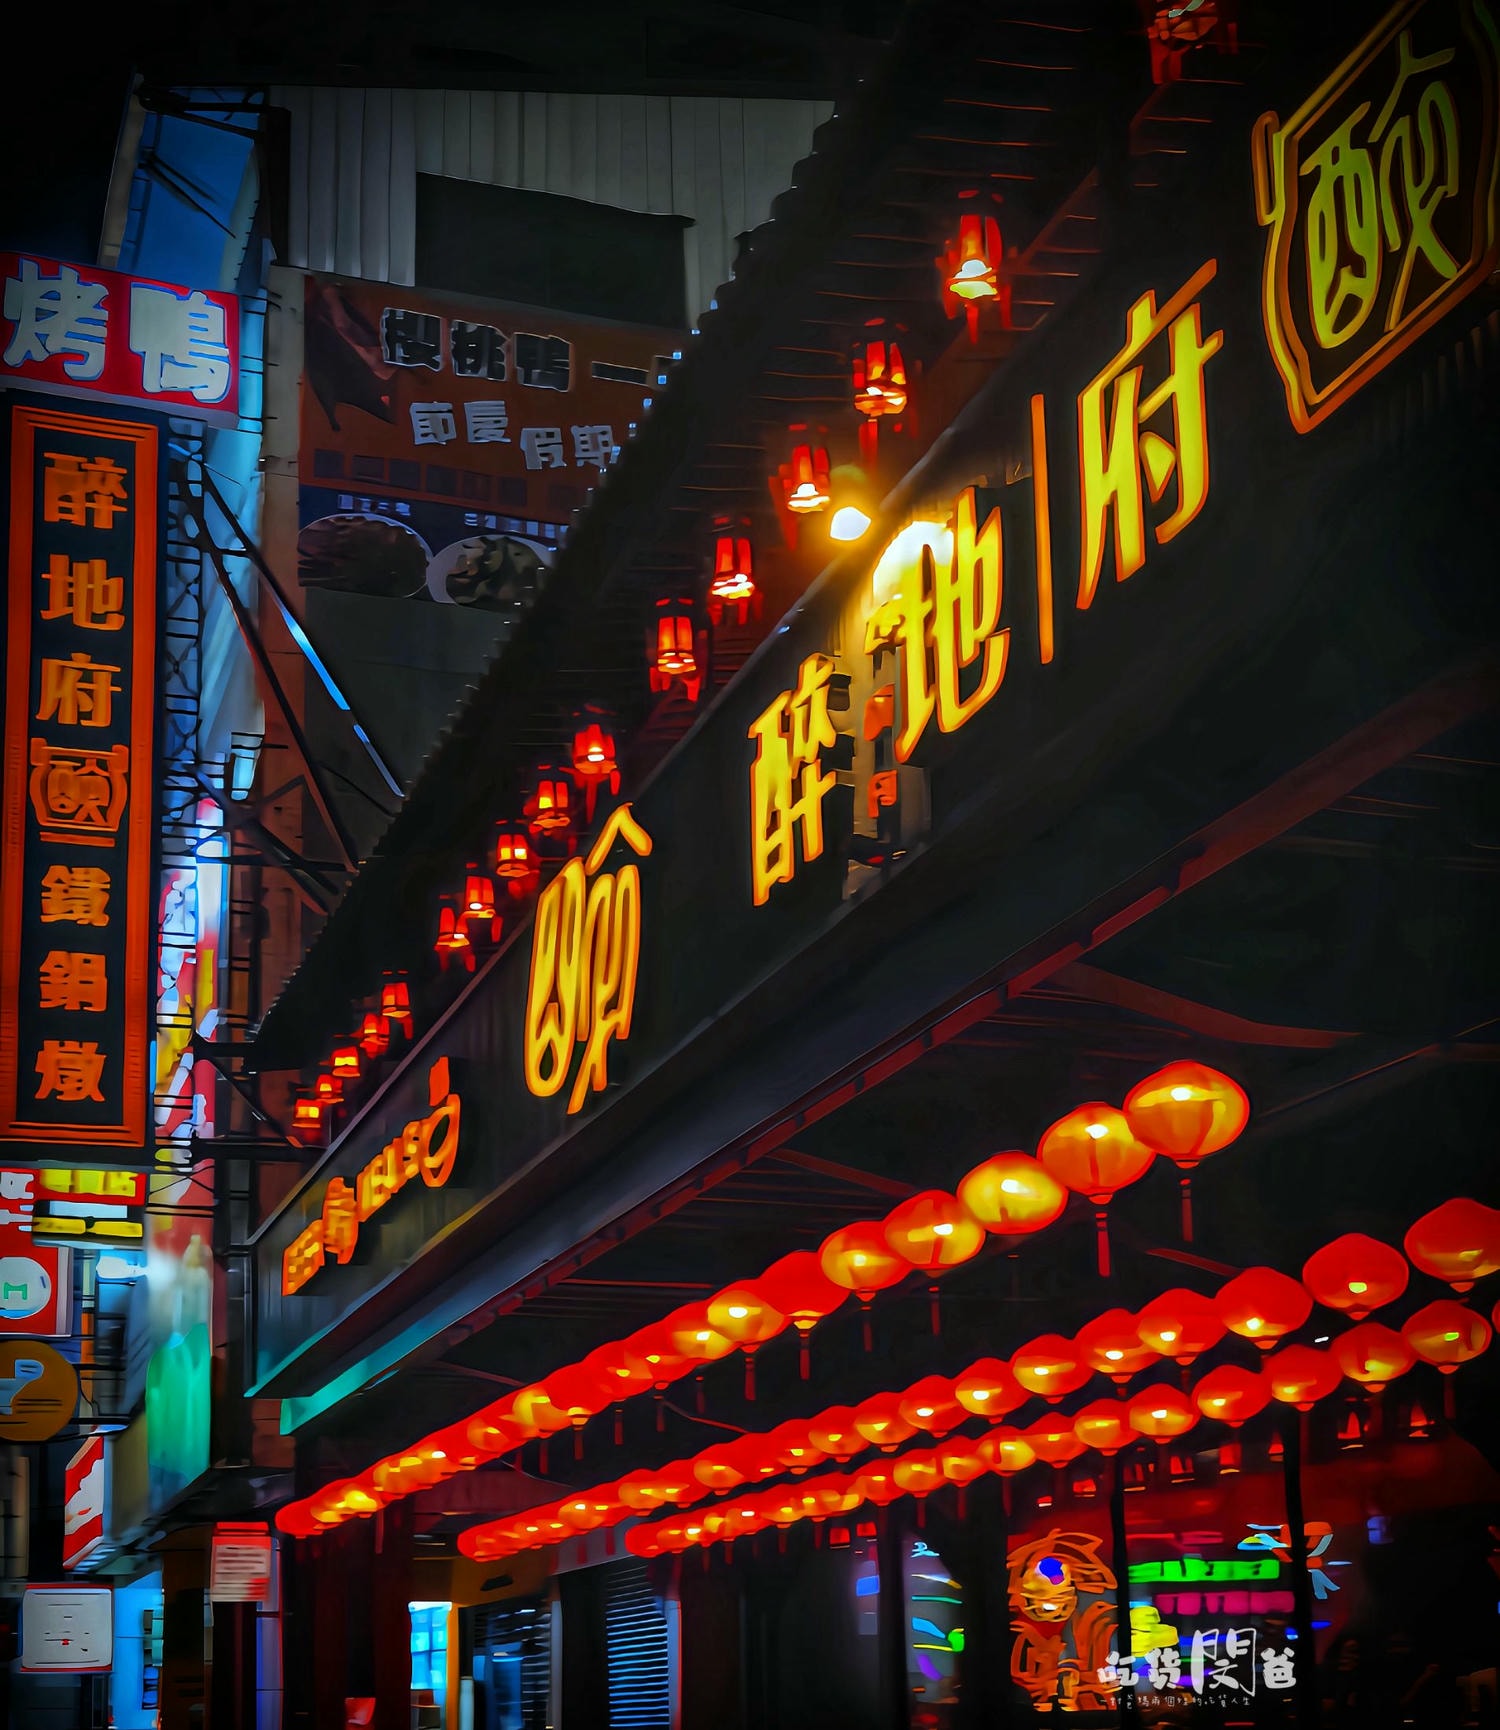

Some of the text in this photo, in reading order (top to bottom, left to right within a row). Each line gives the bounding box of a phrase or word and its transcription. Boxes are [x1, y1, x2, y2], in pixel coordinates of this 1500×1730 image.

[3, 258, 231, 404] 烤鴨
[37, 451, 128, 728] 醉地府
